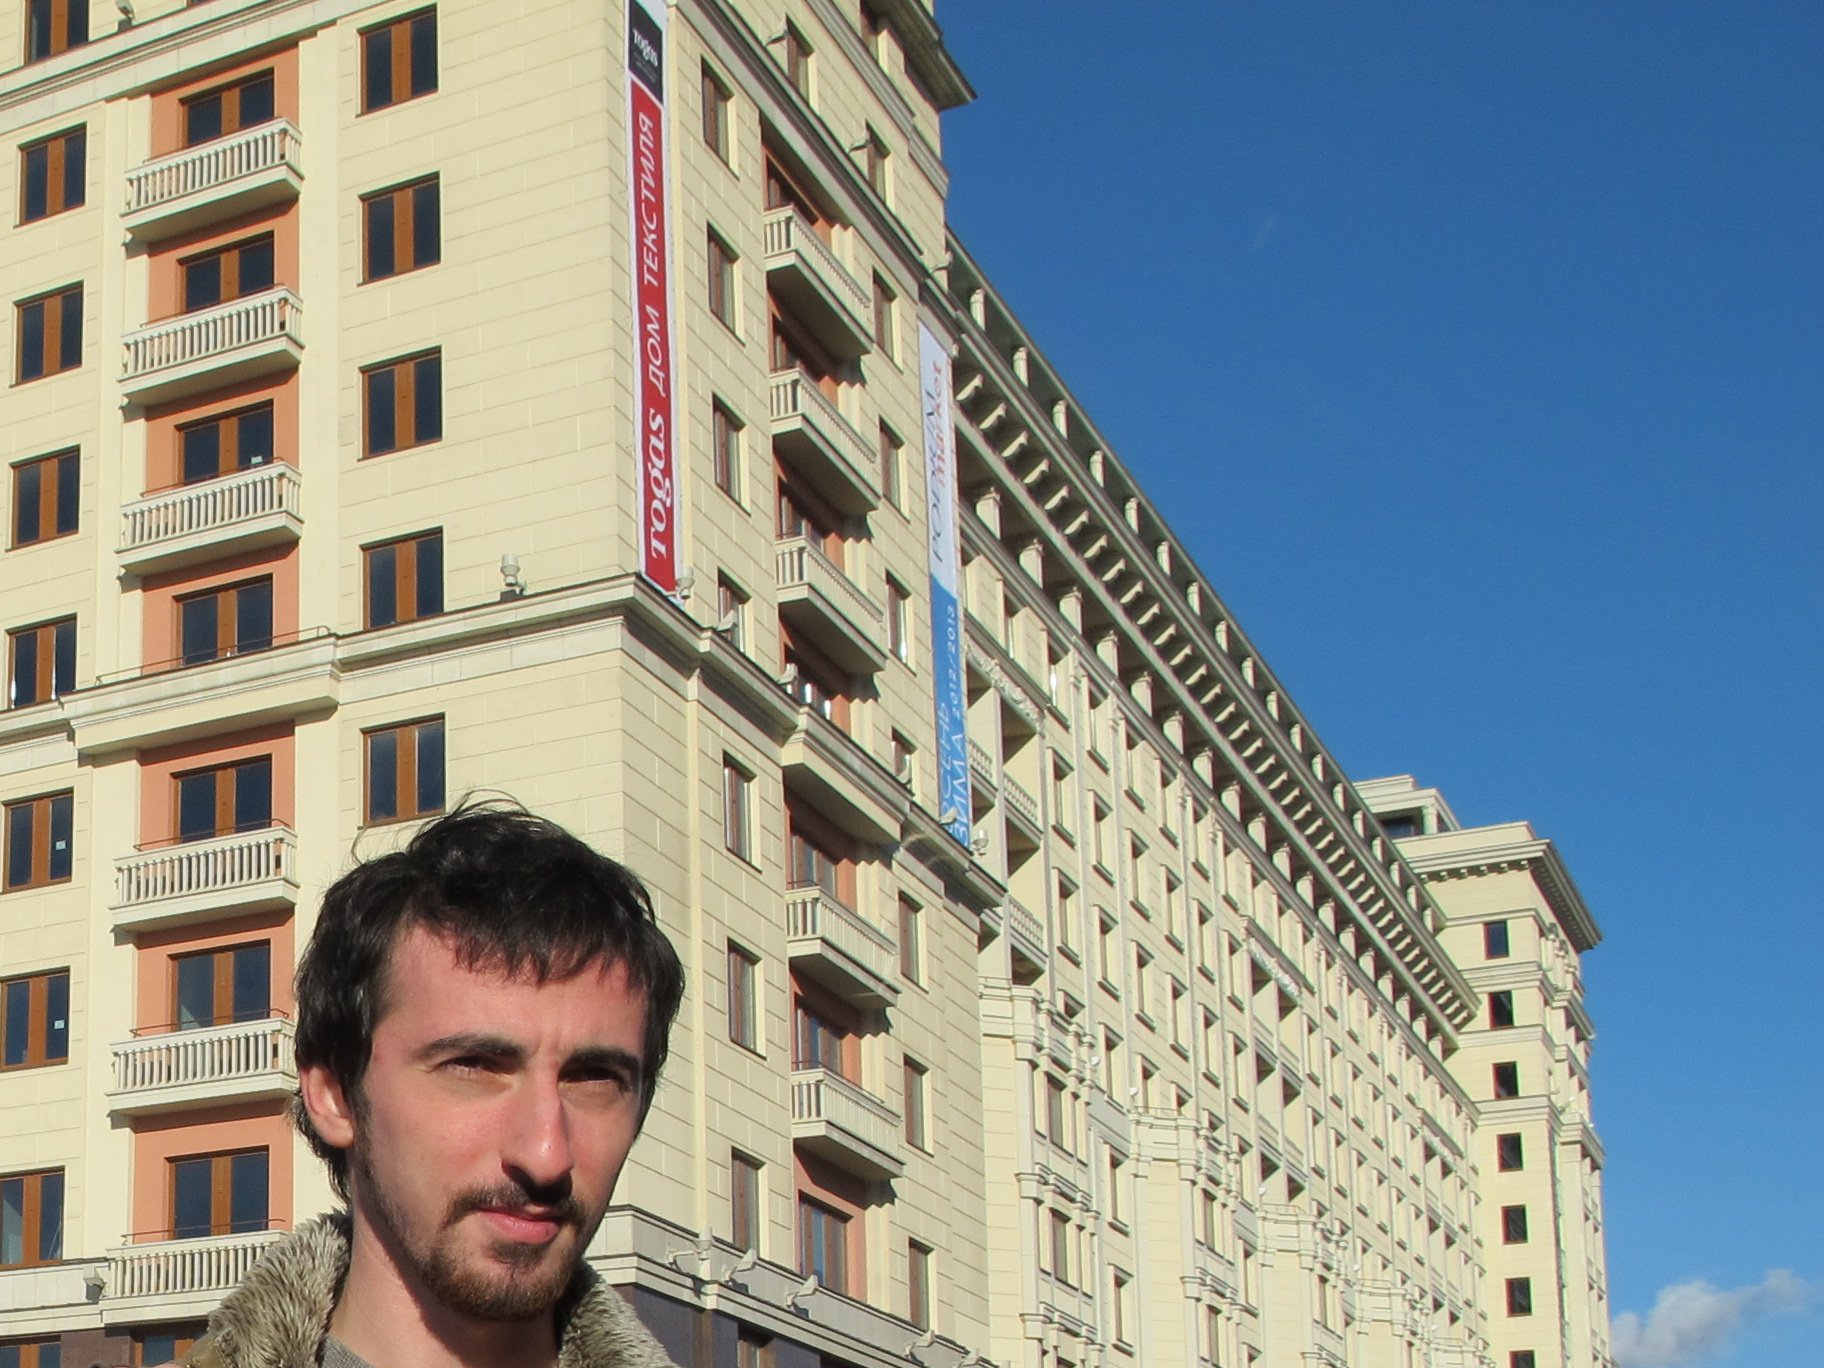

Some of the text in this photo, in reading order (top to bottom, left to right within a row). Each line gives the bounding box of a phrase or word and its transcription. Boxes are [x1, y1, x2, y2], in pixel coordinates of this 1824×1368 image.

[638, 112, 659, 287] ТЕКСТИЛЯ
[645, 304, 666, 398] ДОМ
[933, 361, 946, 488] market
[926, 390, 943, 563] PODIUM
[947, 605, 969, 838] ЗИМА 2012/2013
